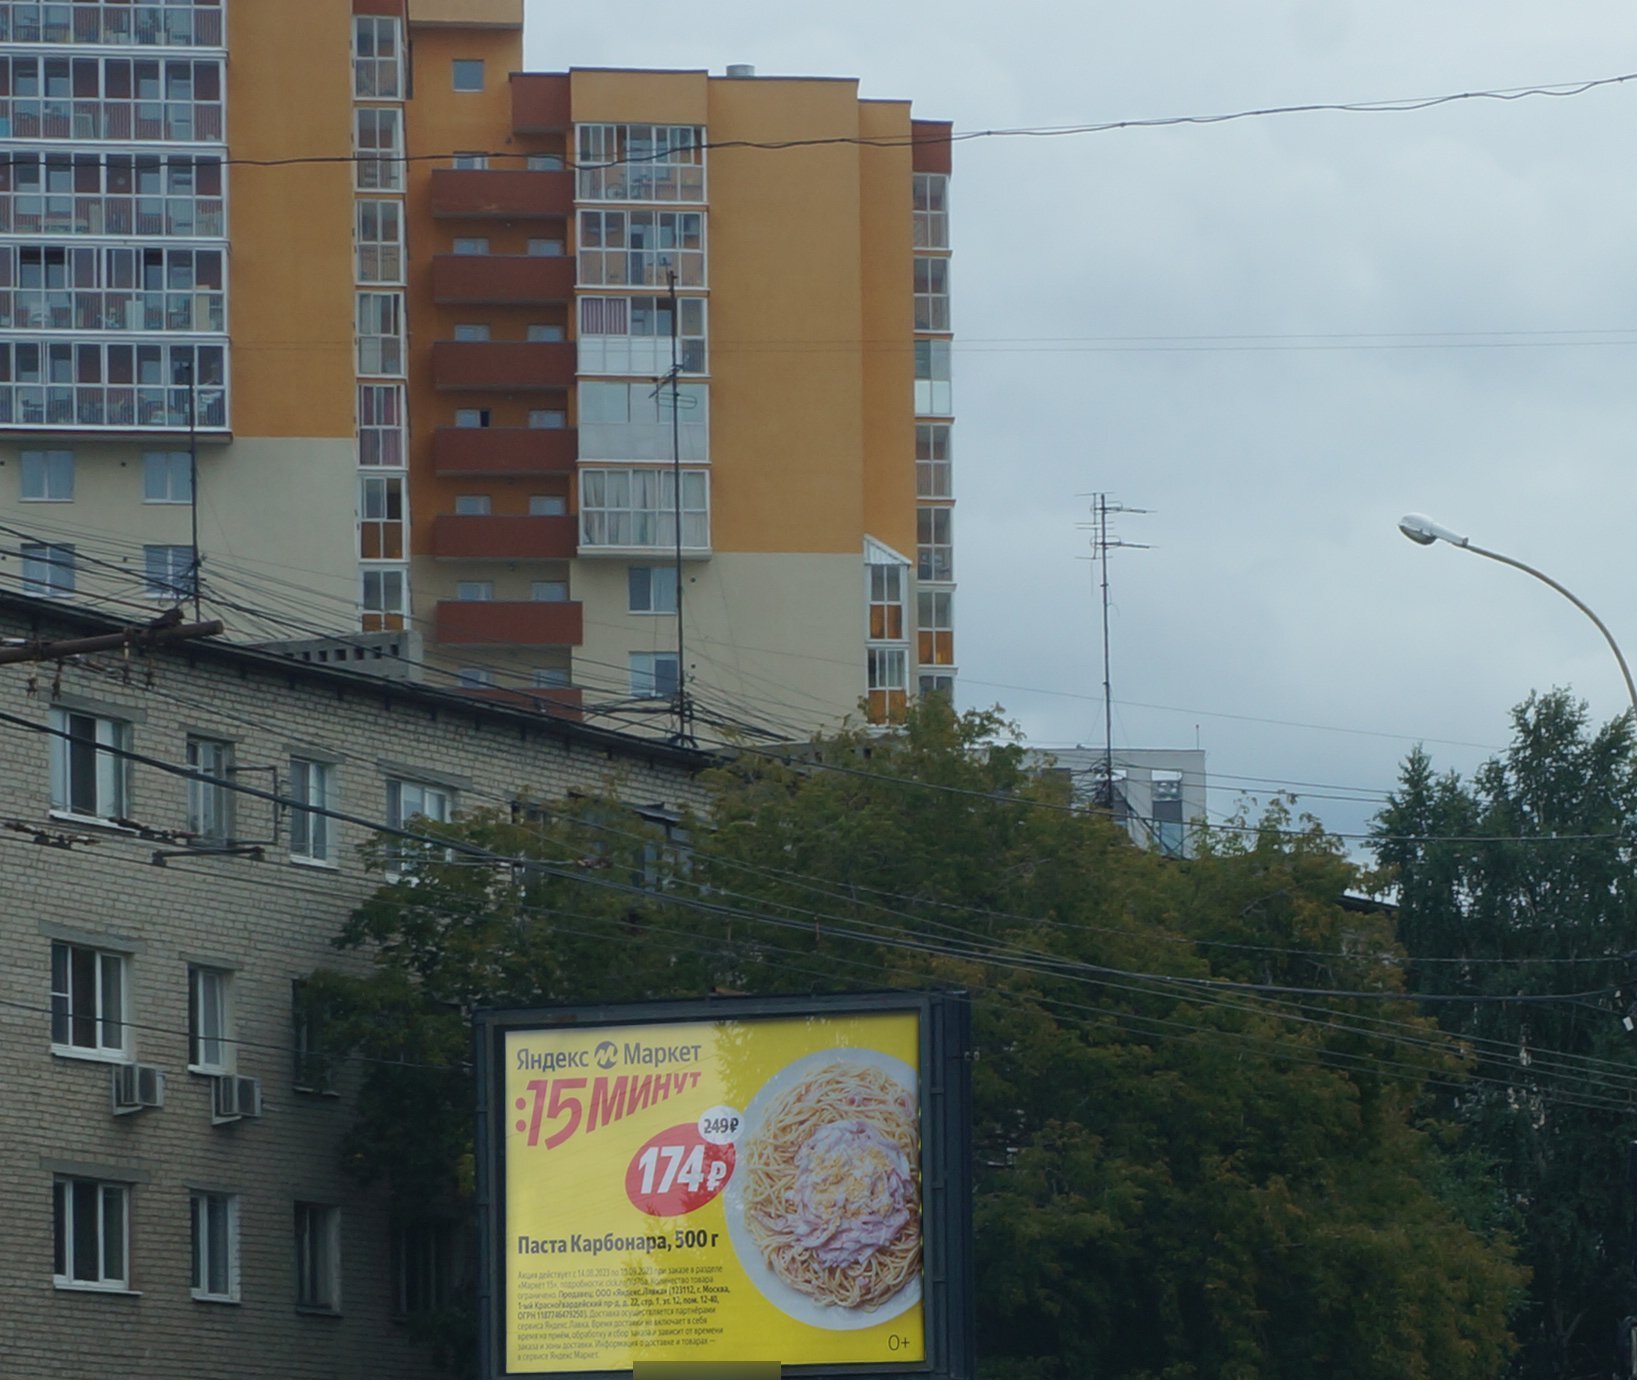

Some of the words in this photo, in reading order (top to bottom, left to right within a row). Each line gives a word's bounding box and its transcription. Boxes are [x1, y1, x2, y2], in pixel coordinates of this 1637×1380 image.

[517, 1048, 589, 1072] Яндекс
[624, 1042, 701, 1067] Маркет
[518, 1236, 567, 1254] Паста
[571, 1233, 671, 1255] Карбонара,
[675, 1230, 707, 1248] 500
[712, 1233, 718, 1247] г
